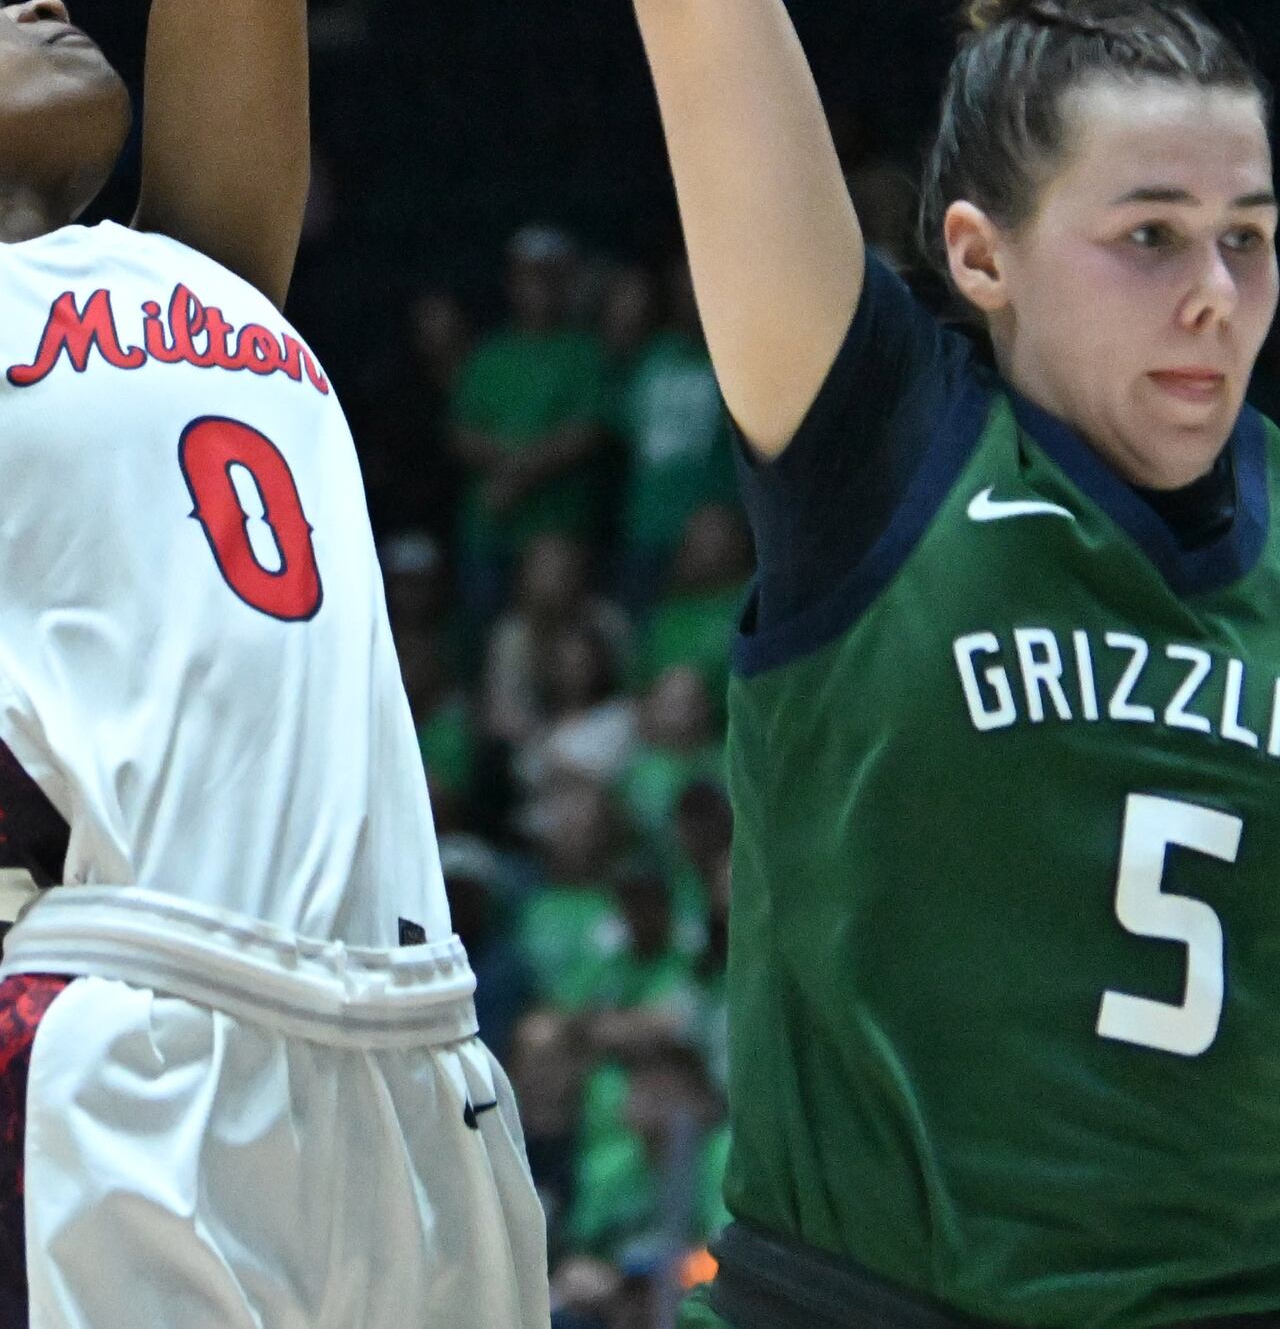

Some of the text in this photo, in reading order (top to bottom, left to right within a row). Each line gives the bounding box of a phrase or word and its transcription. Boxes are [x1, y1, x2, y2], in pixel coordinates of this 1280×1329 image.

[6, 282, 329, 396] Milton
[177, 414, 324, 623] 0
[1096, 791, 1244, 1057] 5
